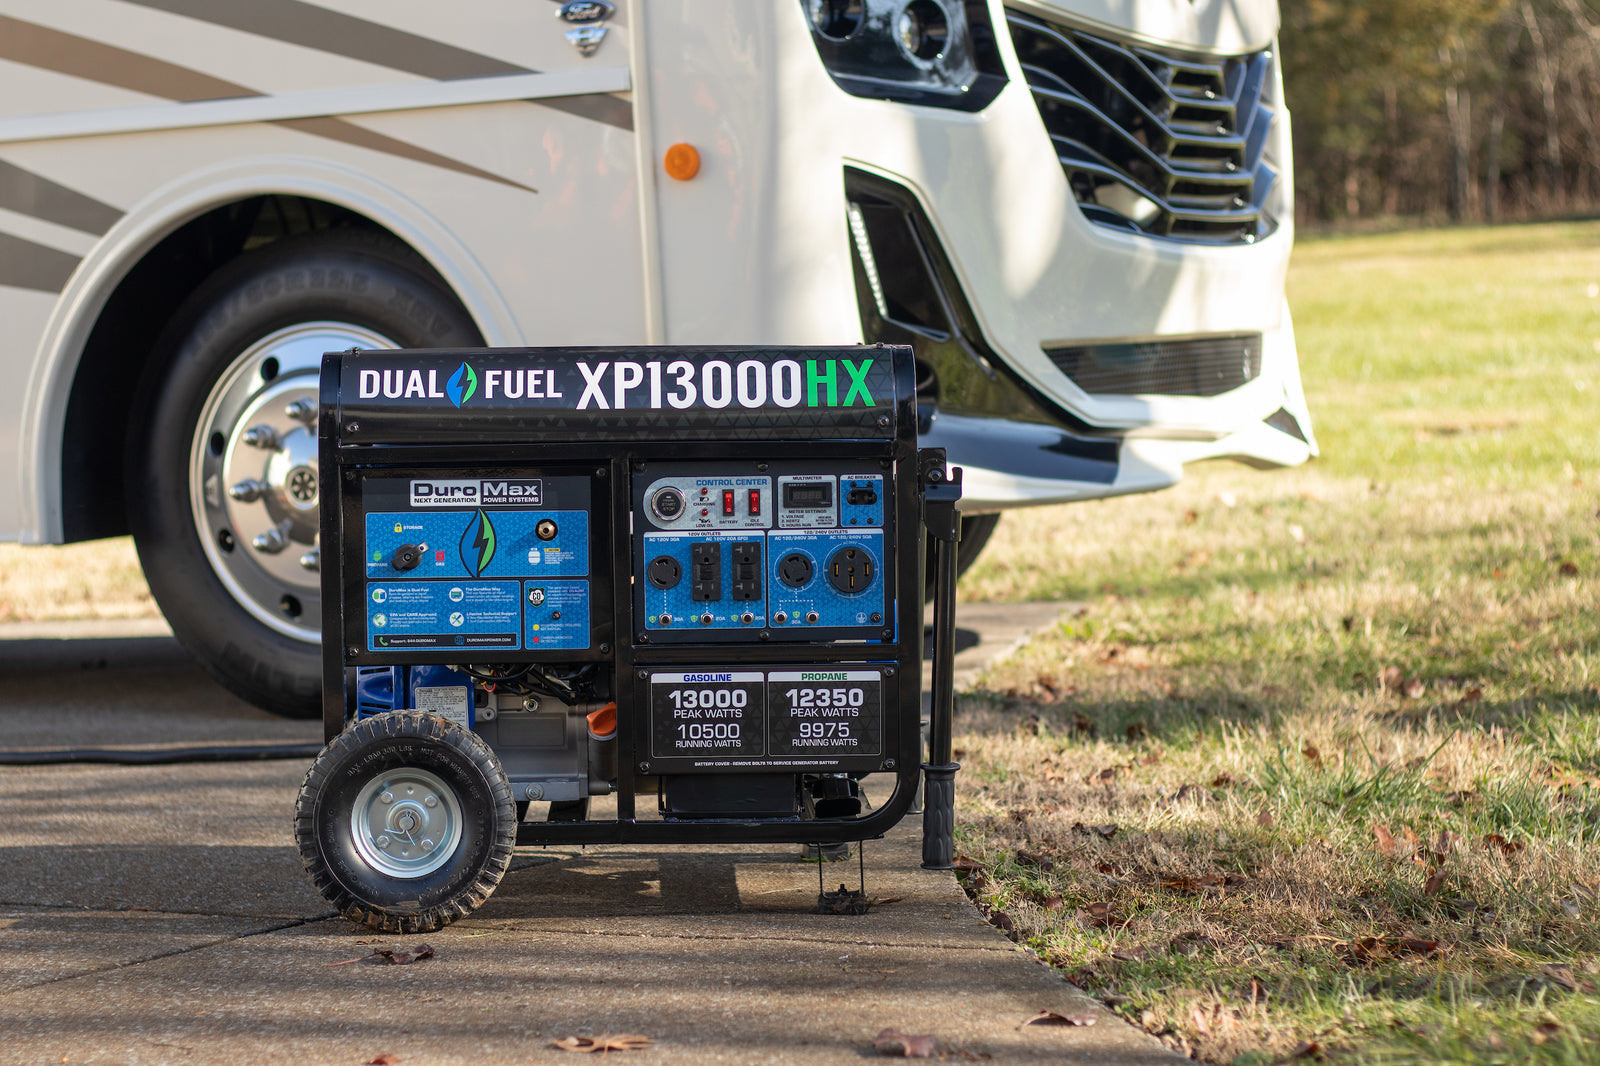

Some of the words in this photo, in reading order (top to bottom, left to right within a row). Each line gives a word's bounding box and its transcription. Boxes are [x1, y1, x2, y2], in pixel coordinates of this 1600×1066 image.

[358, 369, 445, 400] DUAL
[485, 369, 563, 399] FUEL
[575, 358, 877, 411] XP13000HX
[683, 674, 732, 682] GASOLINE
[801, 673, 848, 681] PROPANE
[668, 690, 748, 708] 13000
[785, 688, 864, 708] 12350
[674, 710, 702, 718] PEAK
[704, 710, 742, 718] WATTS
[790, 709, 818, 717] PEAK
[821, 708, 859, 717] WATTS
[677, 723, 740, 739] 10500
[799, 722, 850, 738] 9975
[676, 740, 712, 748] RUNNING
[713, 740, 742, 748] WATTS
[436, 754, 450, 764] FOR
